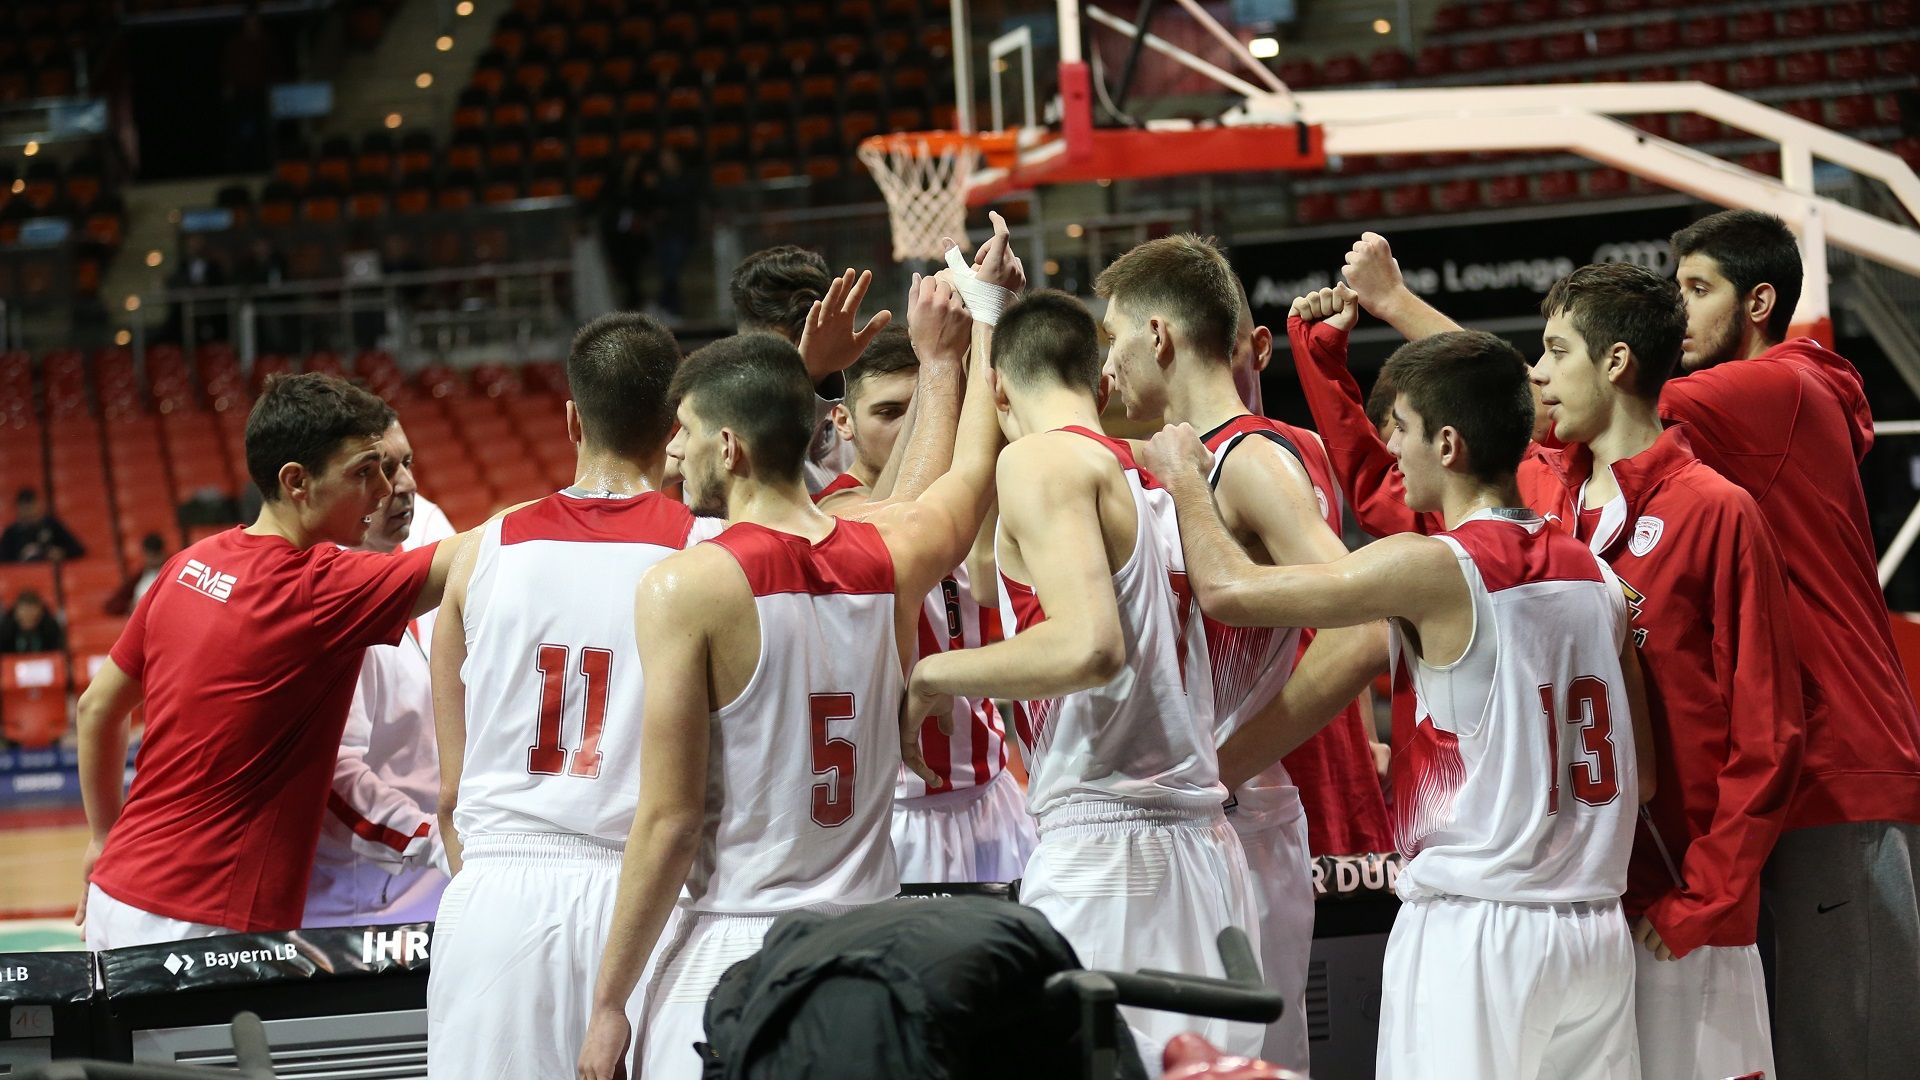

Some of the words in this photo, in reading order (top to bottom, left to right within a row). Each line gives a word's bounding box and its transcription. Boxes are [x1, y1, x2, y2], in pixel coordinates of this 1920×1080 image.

[1444, 257, 1573, 293] Lounge
[527, 643, 613, 779] 11
[808, 692, 857, 828] 5
[1538, 675, 1620, 816] 13
[362, 930, 429, 964] IHR
